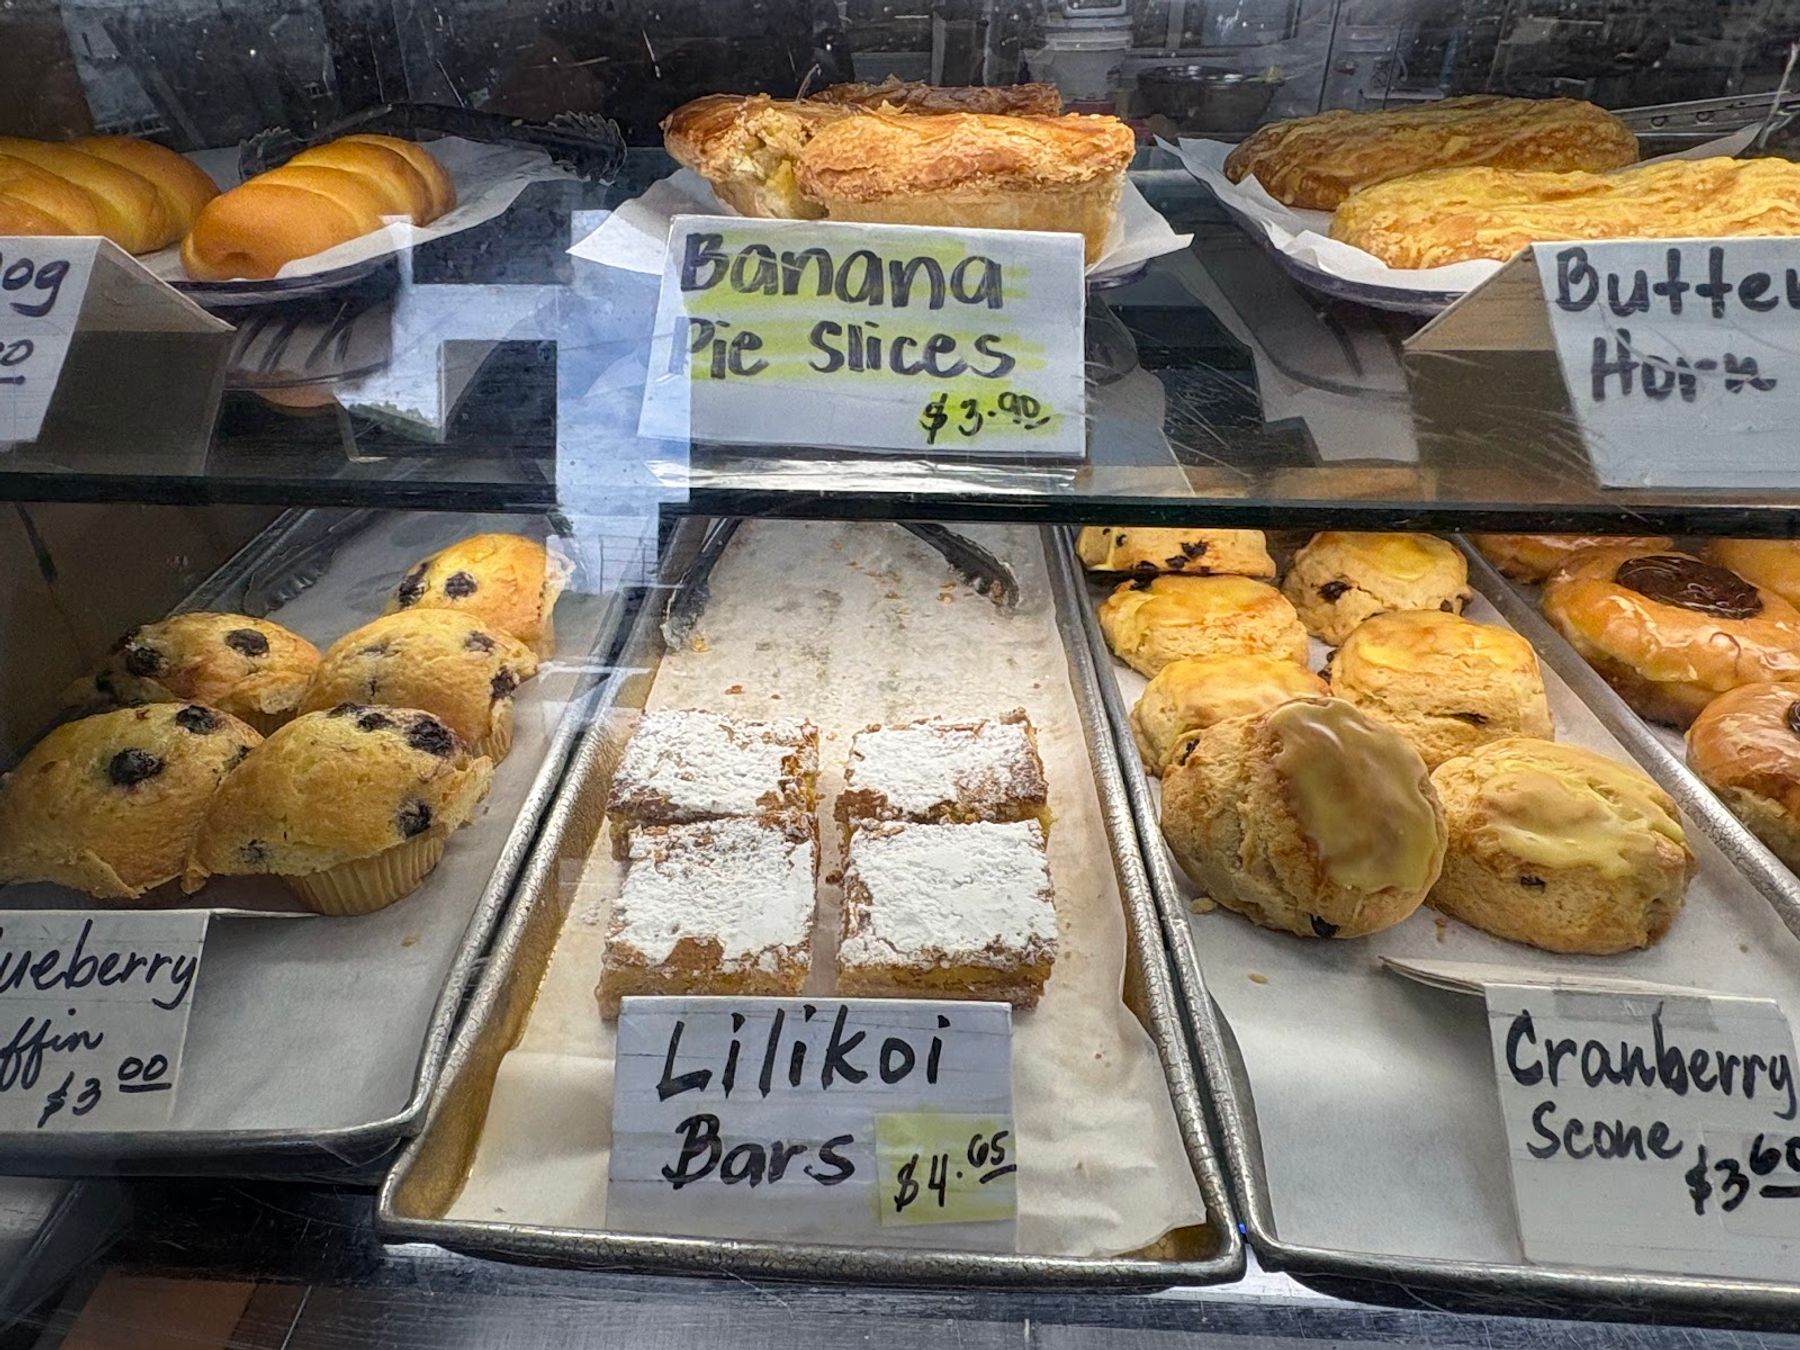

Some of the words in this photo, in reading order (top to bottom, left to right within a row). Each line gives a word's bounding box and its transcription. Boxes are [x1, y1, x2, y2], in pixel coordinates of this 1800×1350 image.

[0, 252, 71, 318] og
[680, 232, 1003, 310] Banana
[668, 316, 770, 380] Pie
[807, 320, 1016, 379] Slices
[1590, 327, 1778, 403] Horn
[0, 918, 198, 1011] ueberry
[0, 1007, 104, 1092] ffin
[656, 1004, 951, 1102] Lilikoi
[1505, 1000, 1798, 1121] Cranberry
[661, 1113, 856, 1190] Bars
[1526, 1100, 1684, 1161] Scone
